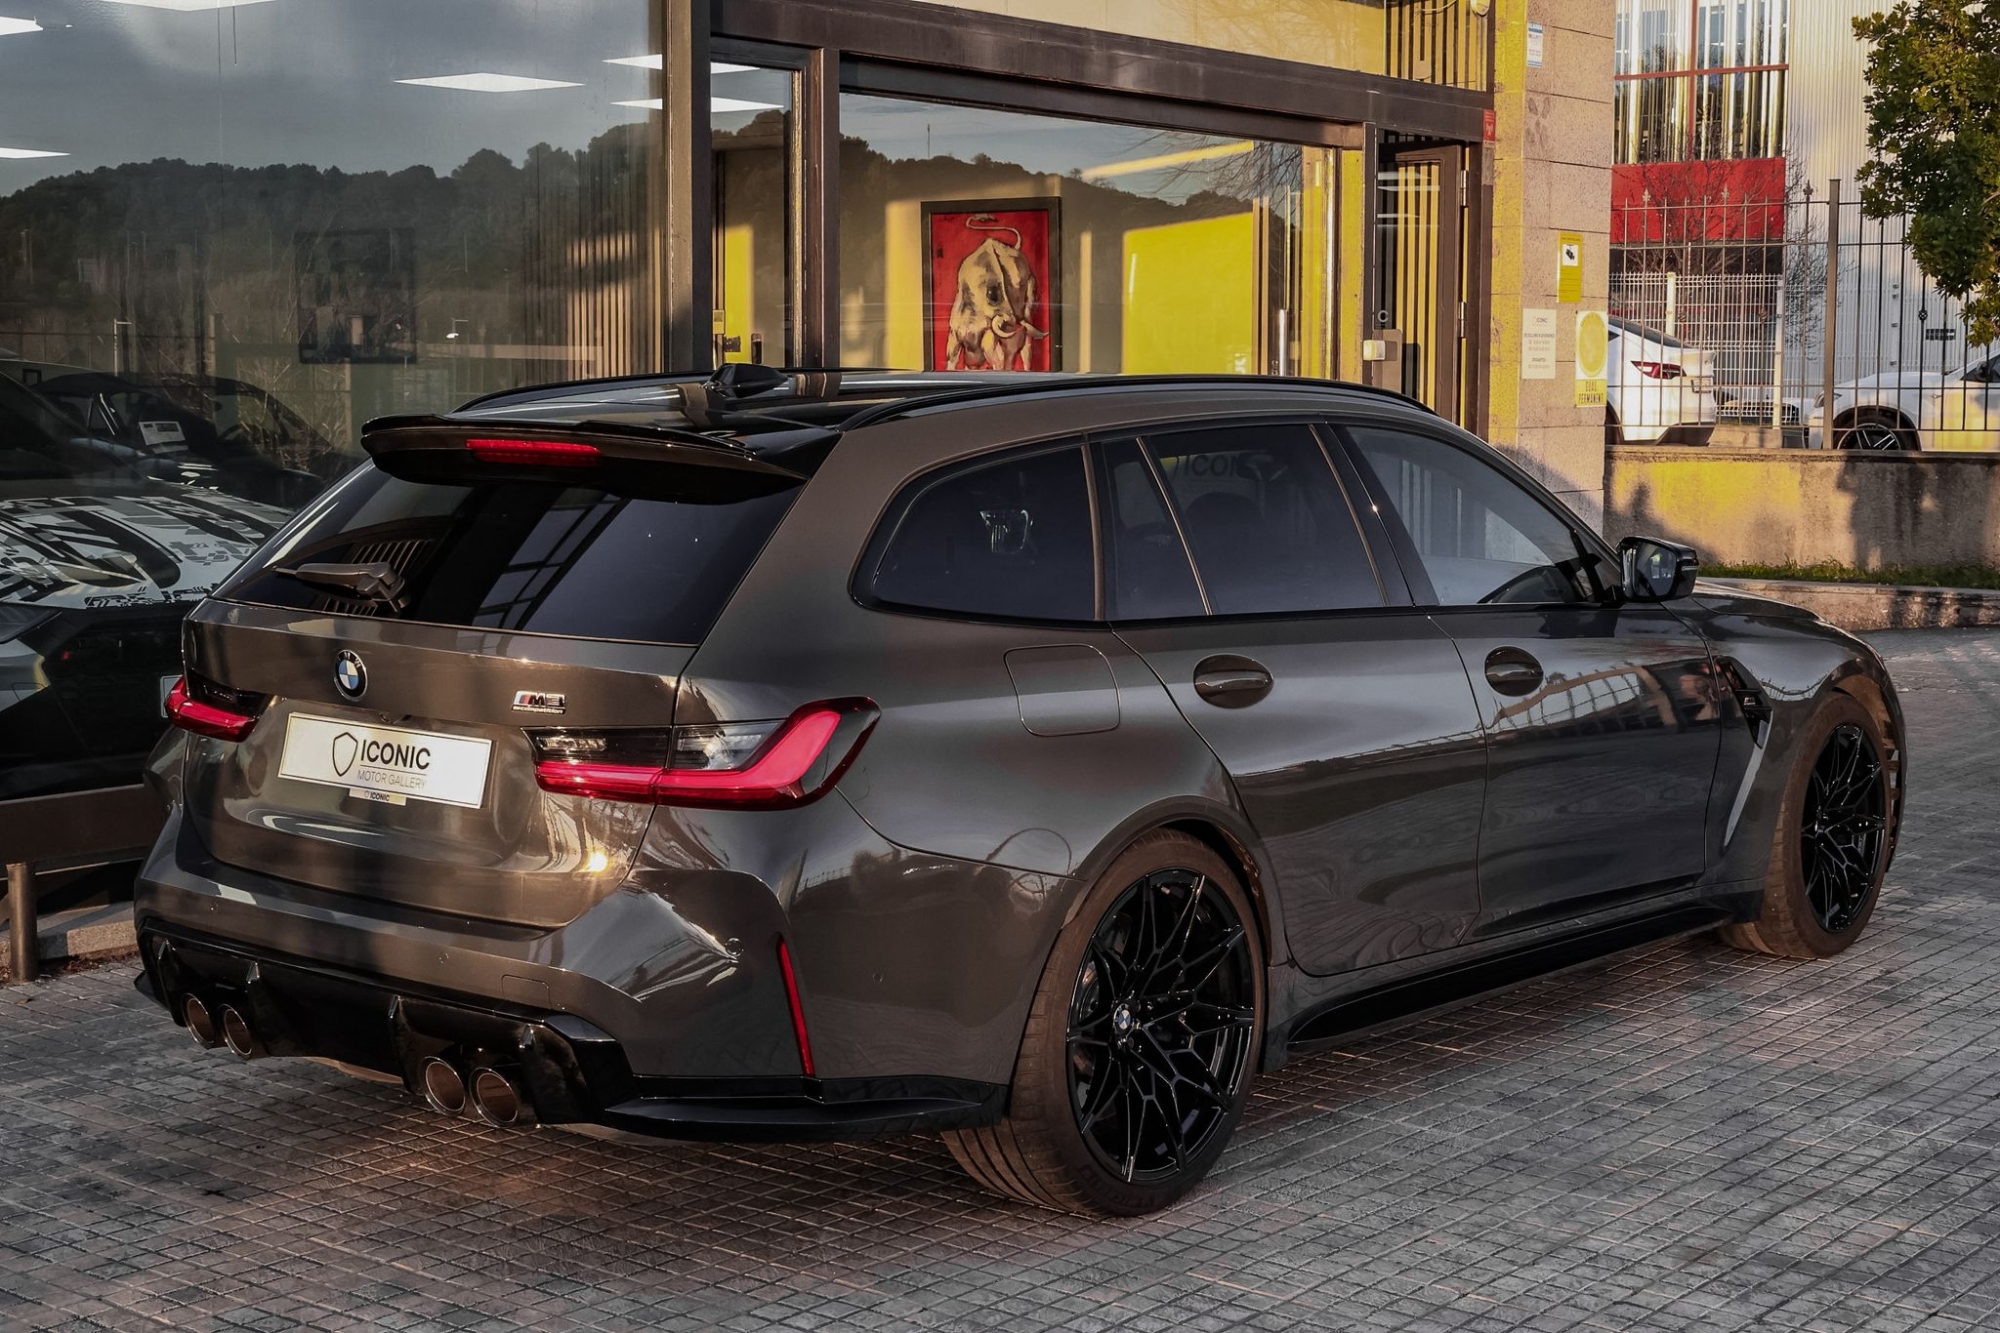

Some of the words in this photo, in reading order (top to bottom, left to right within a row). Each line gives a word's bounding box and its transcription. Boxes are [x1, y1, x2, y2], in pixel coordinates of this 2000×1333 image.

[361, 739, 431, 770] ICONIC
[357, 770, 387, 783] MOTOR
[389, 774, 425, 789] GALLERY
[370, 792, 390, 801] ICONIC
